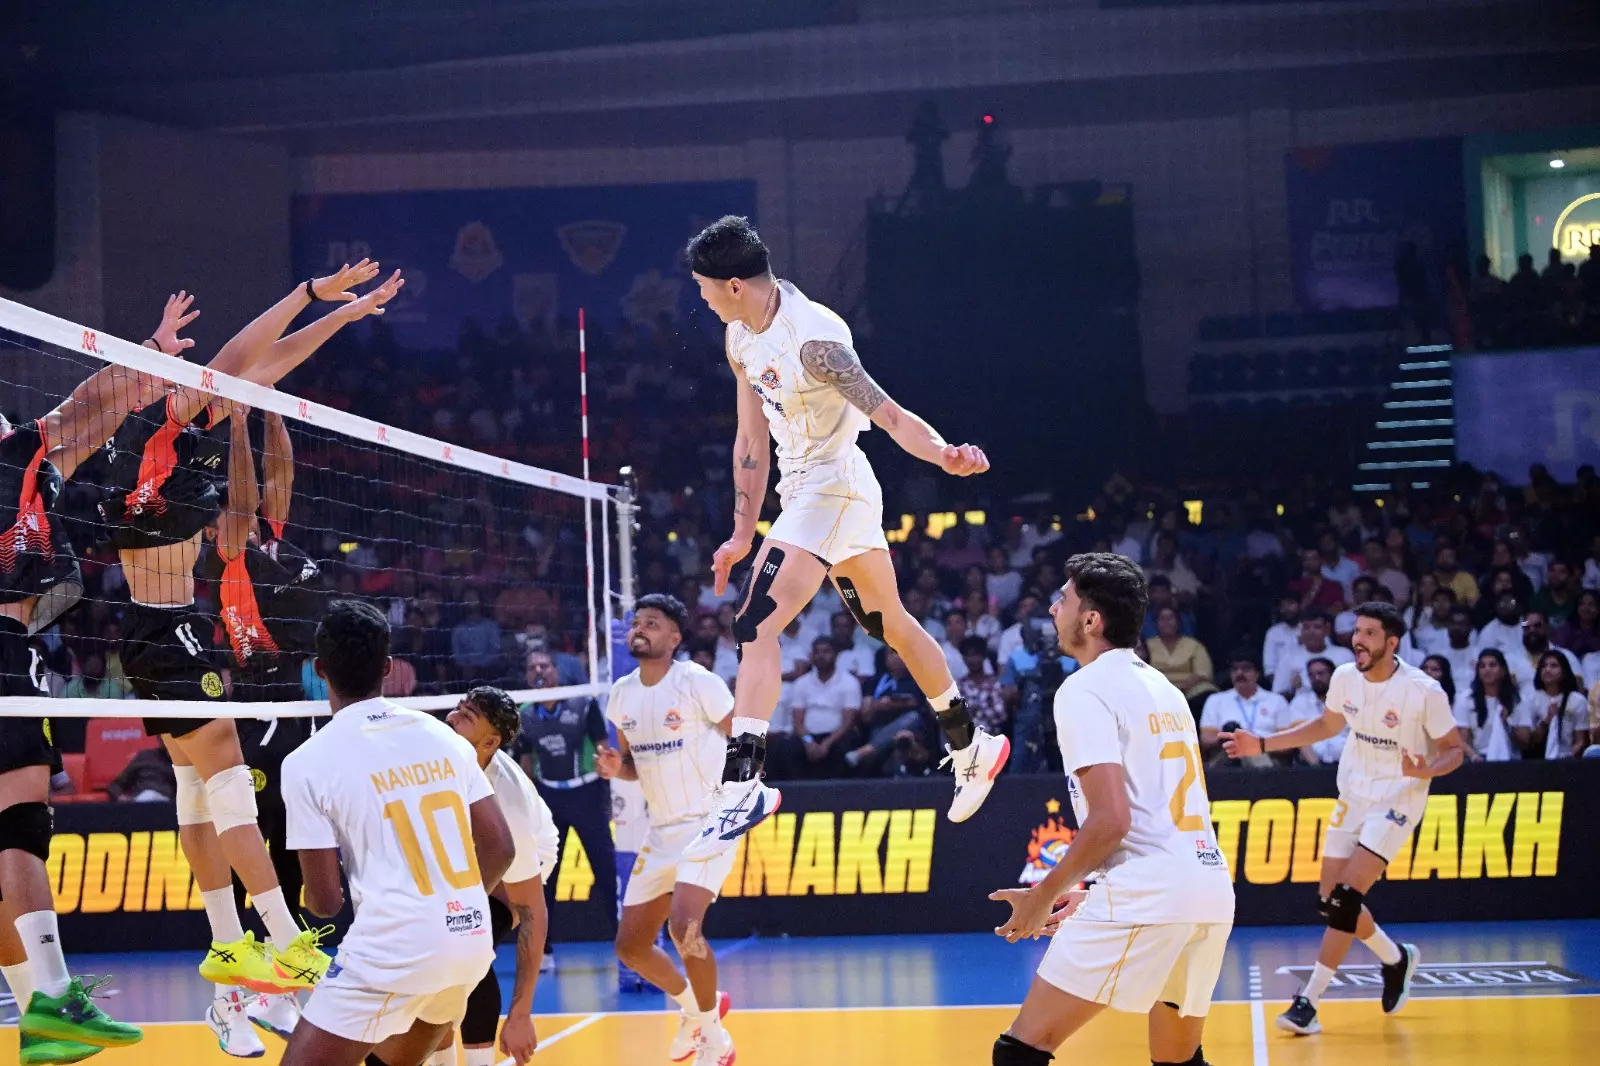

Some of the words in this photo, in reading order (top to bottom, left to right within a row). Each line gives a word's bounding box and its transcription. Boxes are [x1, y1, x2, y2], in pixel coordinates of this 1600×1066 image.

[763, 562, 778, 576] TST
[843, 589, 856, 599] TST
[370, 757, 456, 794] NANDHA
[383, 789, 482, 897] 10
[1210, 791, 1563, 884] TODAKH
[446, 913, 472, 926] Prime
[449, 923, 473, 933] Volleyball
